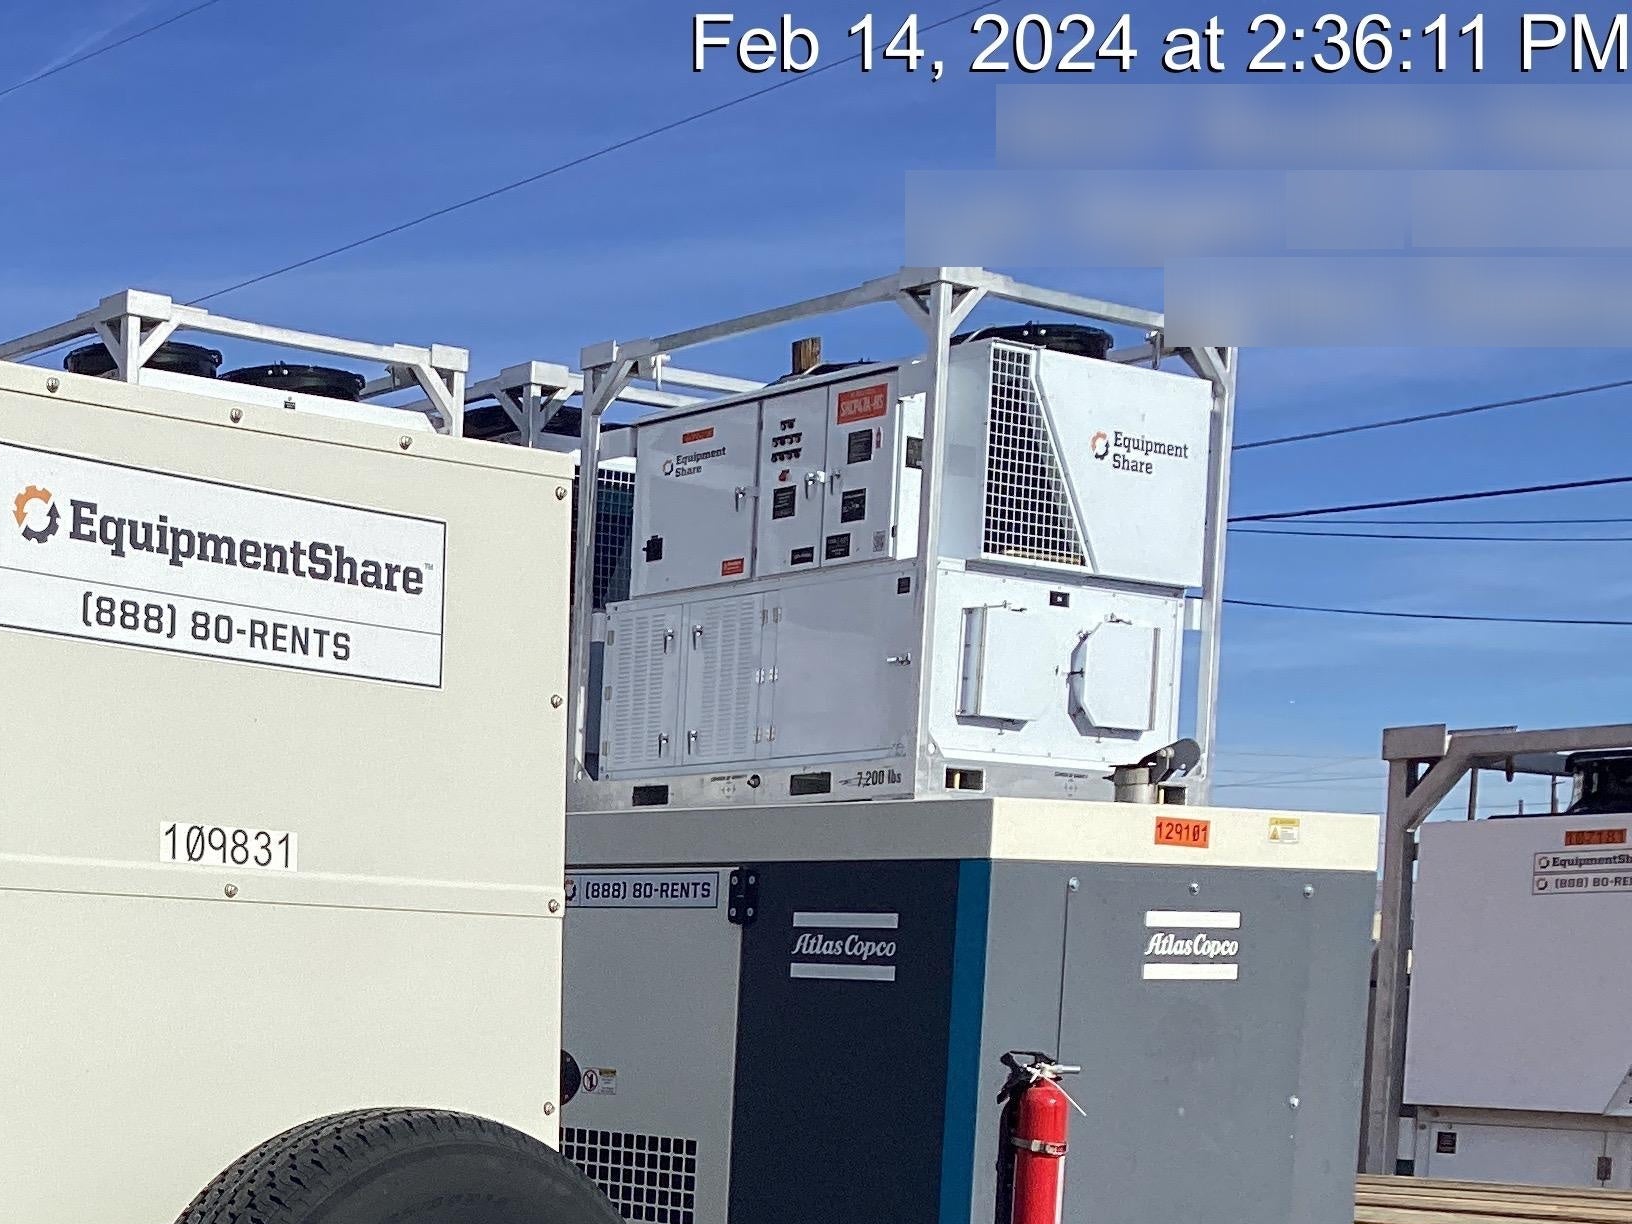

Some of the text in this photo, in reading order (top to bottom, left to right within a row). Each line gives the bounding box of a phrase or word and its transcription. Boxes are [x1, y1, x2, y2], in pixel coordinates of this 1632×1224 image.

[676, 446, 727, 466] Equipment
[1113, 431, 1189, 459] Equipment
[675, 465, 703, 478] Share
[1112, 453, 1153, 475] Share
[69, 498, 424, 595] EquipmentShare
[82, 590, 352, 661] (888) 80-RENTS
[888, 769, 902, 784] lbs
[1156, 820, 1209, 842] 129101
[164, 822, 292, 868] 109831
[585, 880, 711, 901] (888) 80-RENTS
